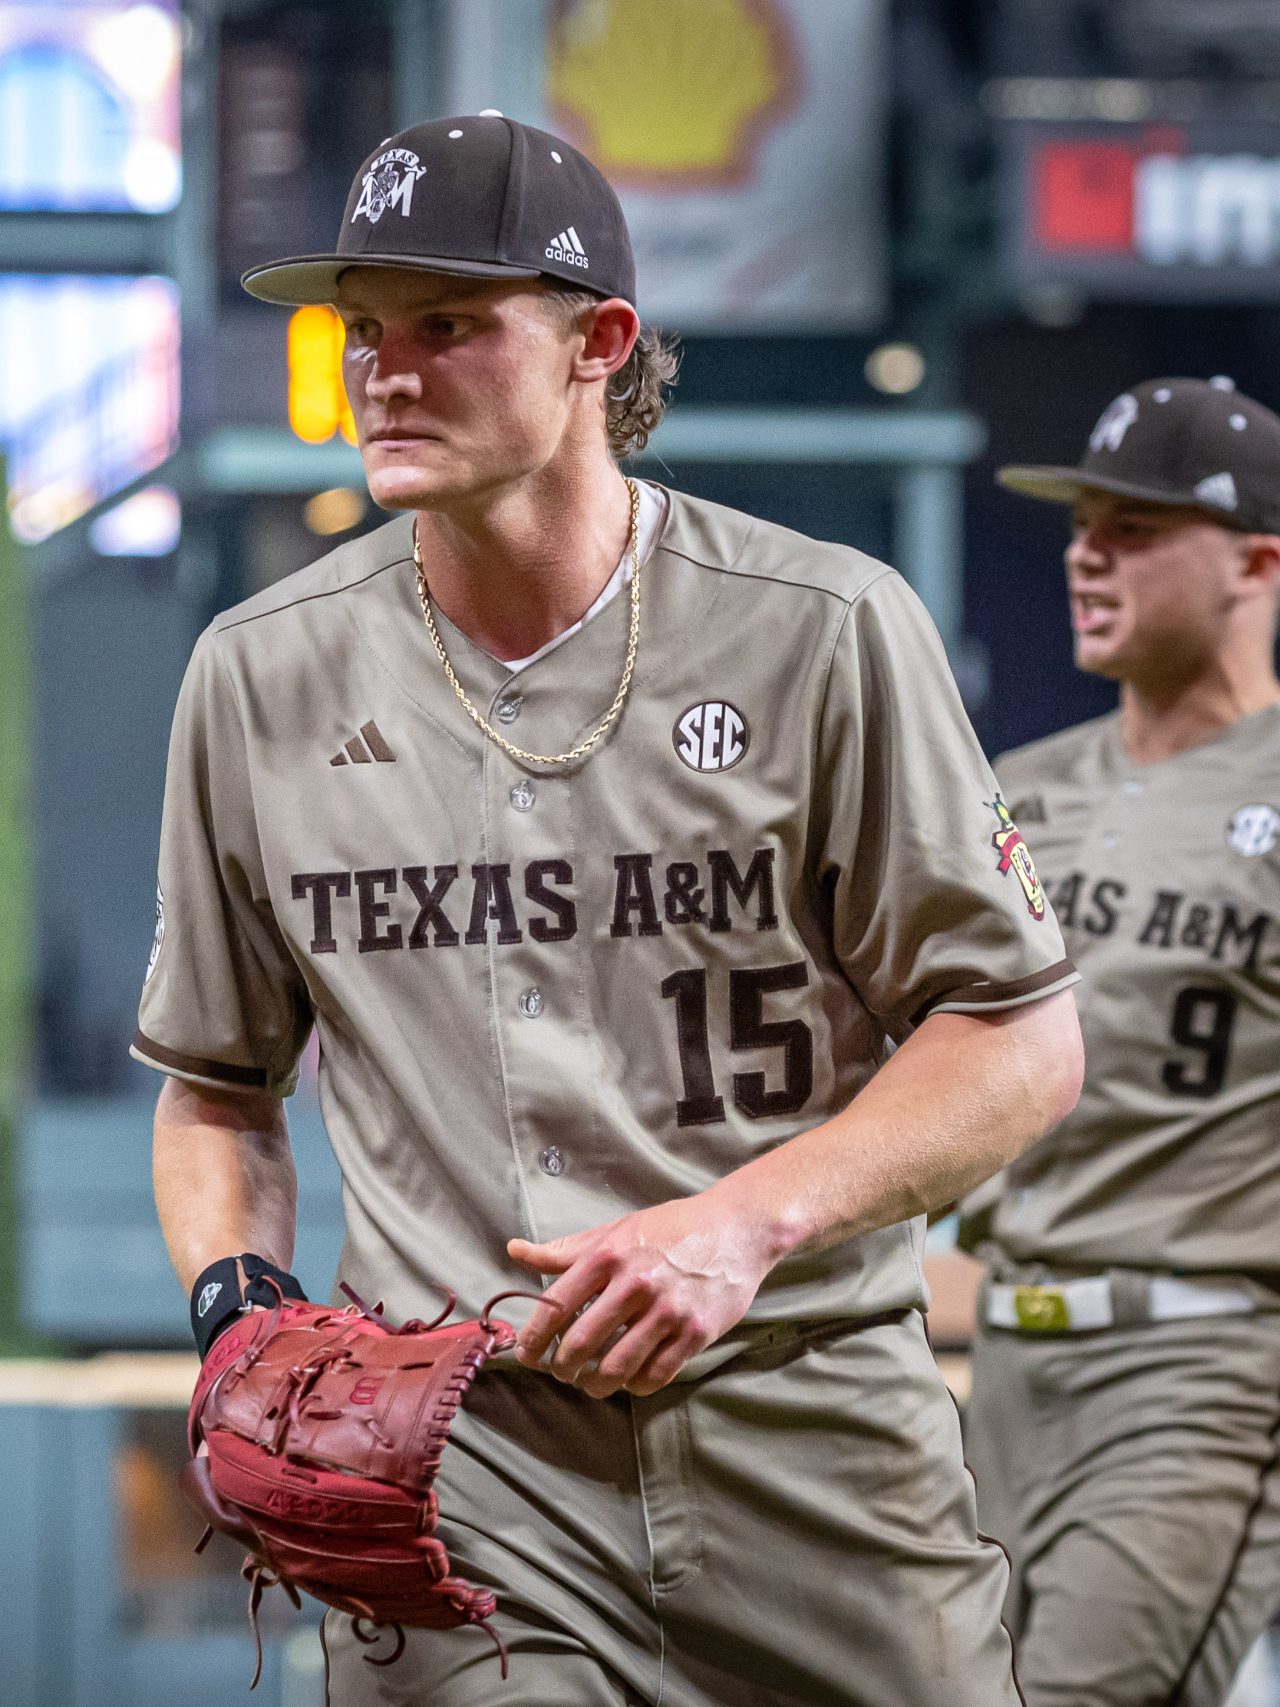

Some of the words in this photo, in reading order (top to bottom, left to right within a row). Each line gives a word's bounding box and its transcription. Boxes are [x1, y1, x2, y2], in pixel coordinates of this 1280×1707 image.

[545, 247, 589, 269] adidas
[678, 702, 745, 770] SEC
[291, 859, 578, 954] TEXAS
[610, 848, 779, 938] A&M
[1138, 886, 1273, 972] A&M
[661, 961, 813, 1127] 15
[1162, 985, 1236, 1098] 9
